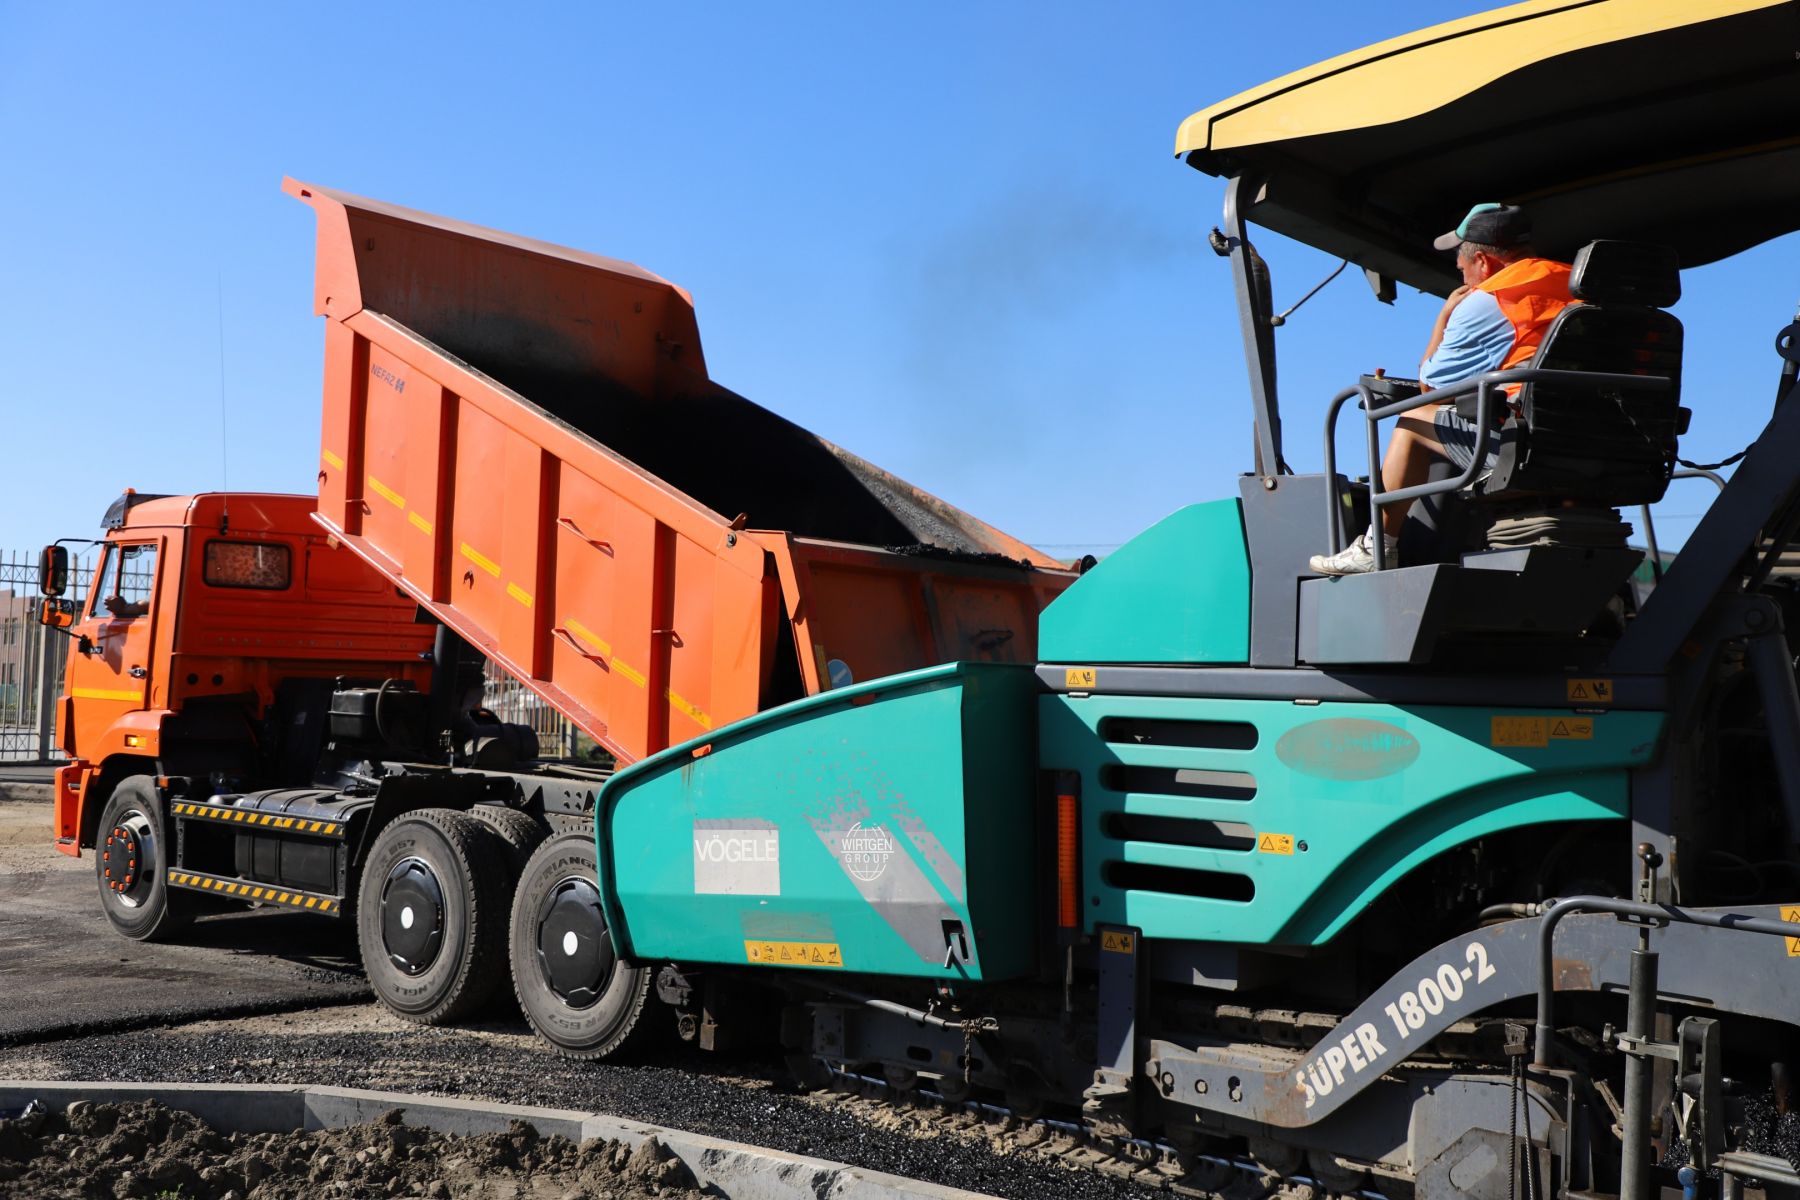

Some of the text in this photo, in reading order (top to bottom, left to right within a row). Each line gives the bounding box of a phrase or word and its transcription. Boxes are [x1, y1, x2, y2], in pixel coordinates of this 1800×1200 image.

[694, 834, 778, 862] VÖGELE
[841, 838, 893, 851] WIRTGEN
[845, 853, 889, 863] GROUP
[1295, 941, 1497, 1108] SUPER 1800-2
